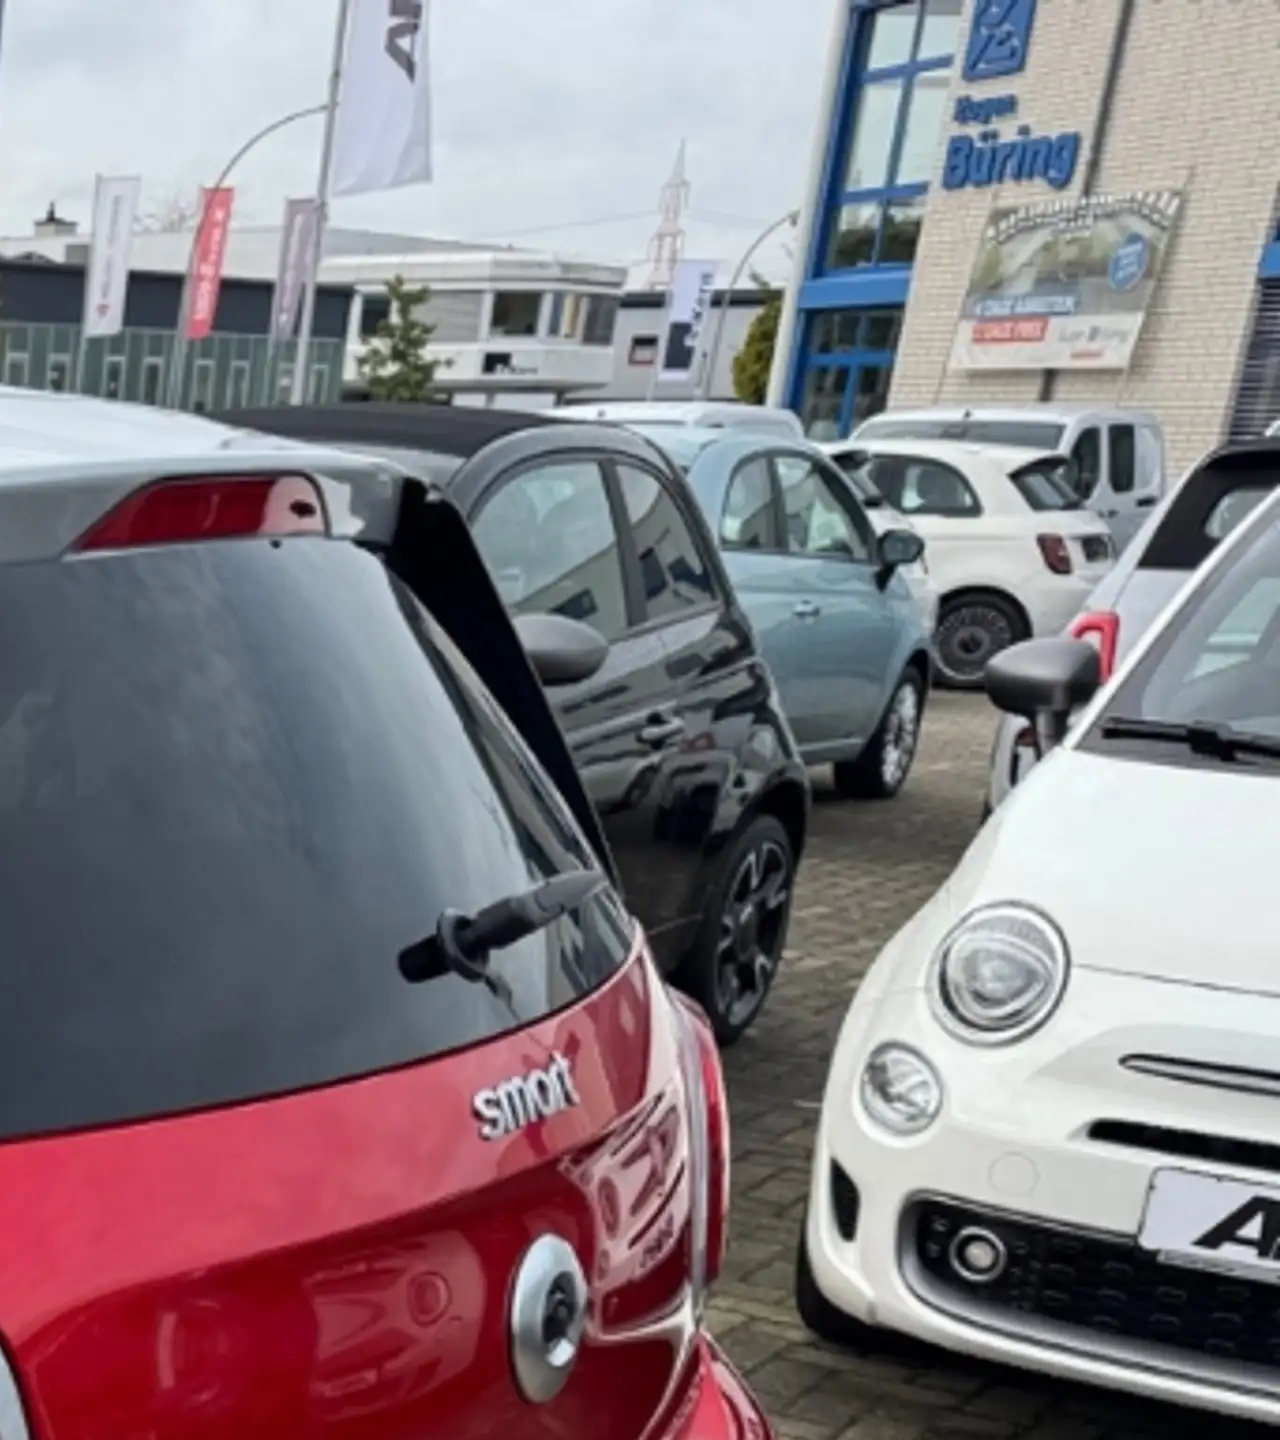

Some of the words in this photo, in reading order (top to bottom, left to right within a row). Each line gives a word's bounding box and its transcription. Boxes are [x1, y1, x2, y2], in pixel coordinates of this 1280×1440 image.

[942, 124, 1082, 190] Büring
[471, 1050, 581, 1141] smart
[1189, 1194, 1280, 1261] A
